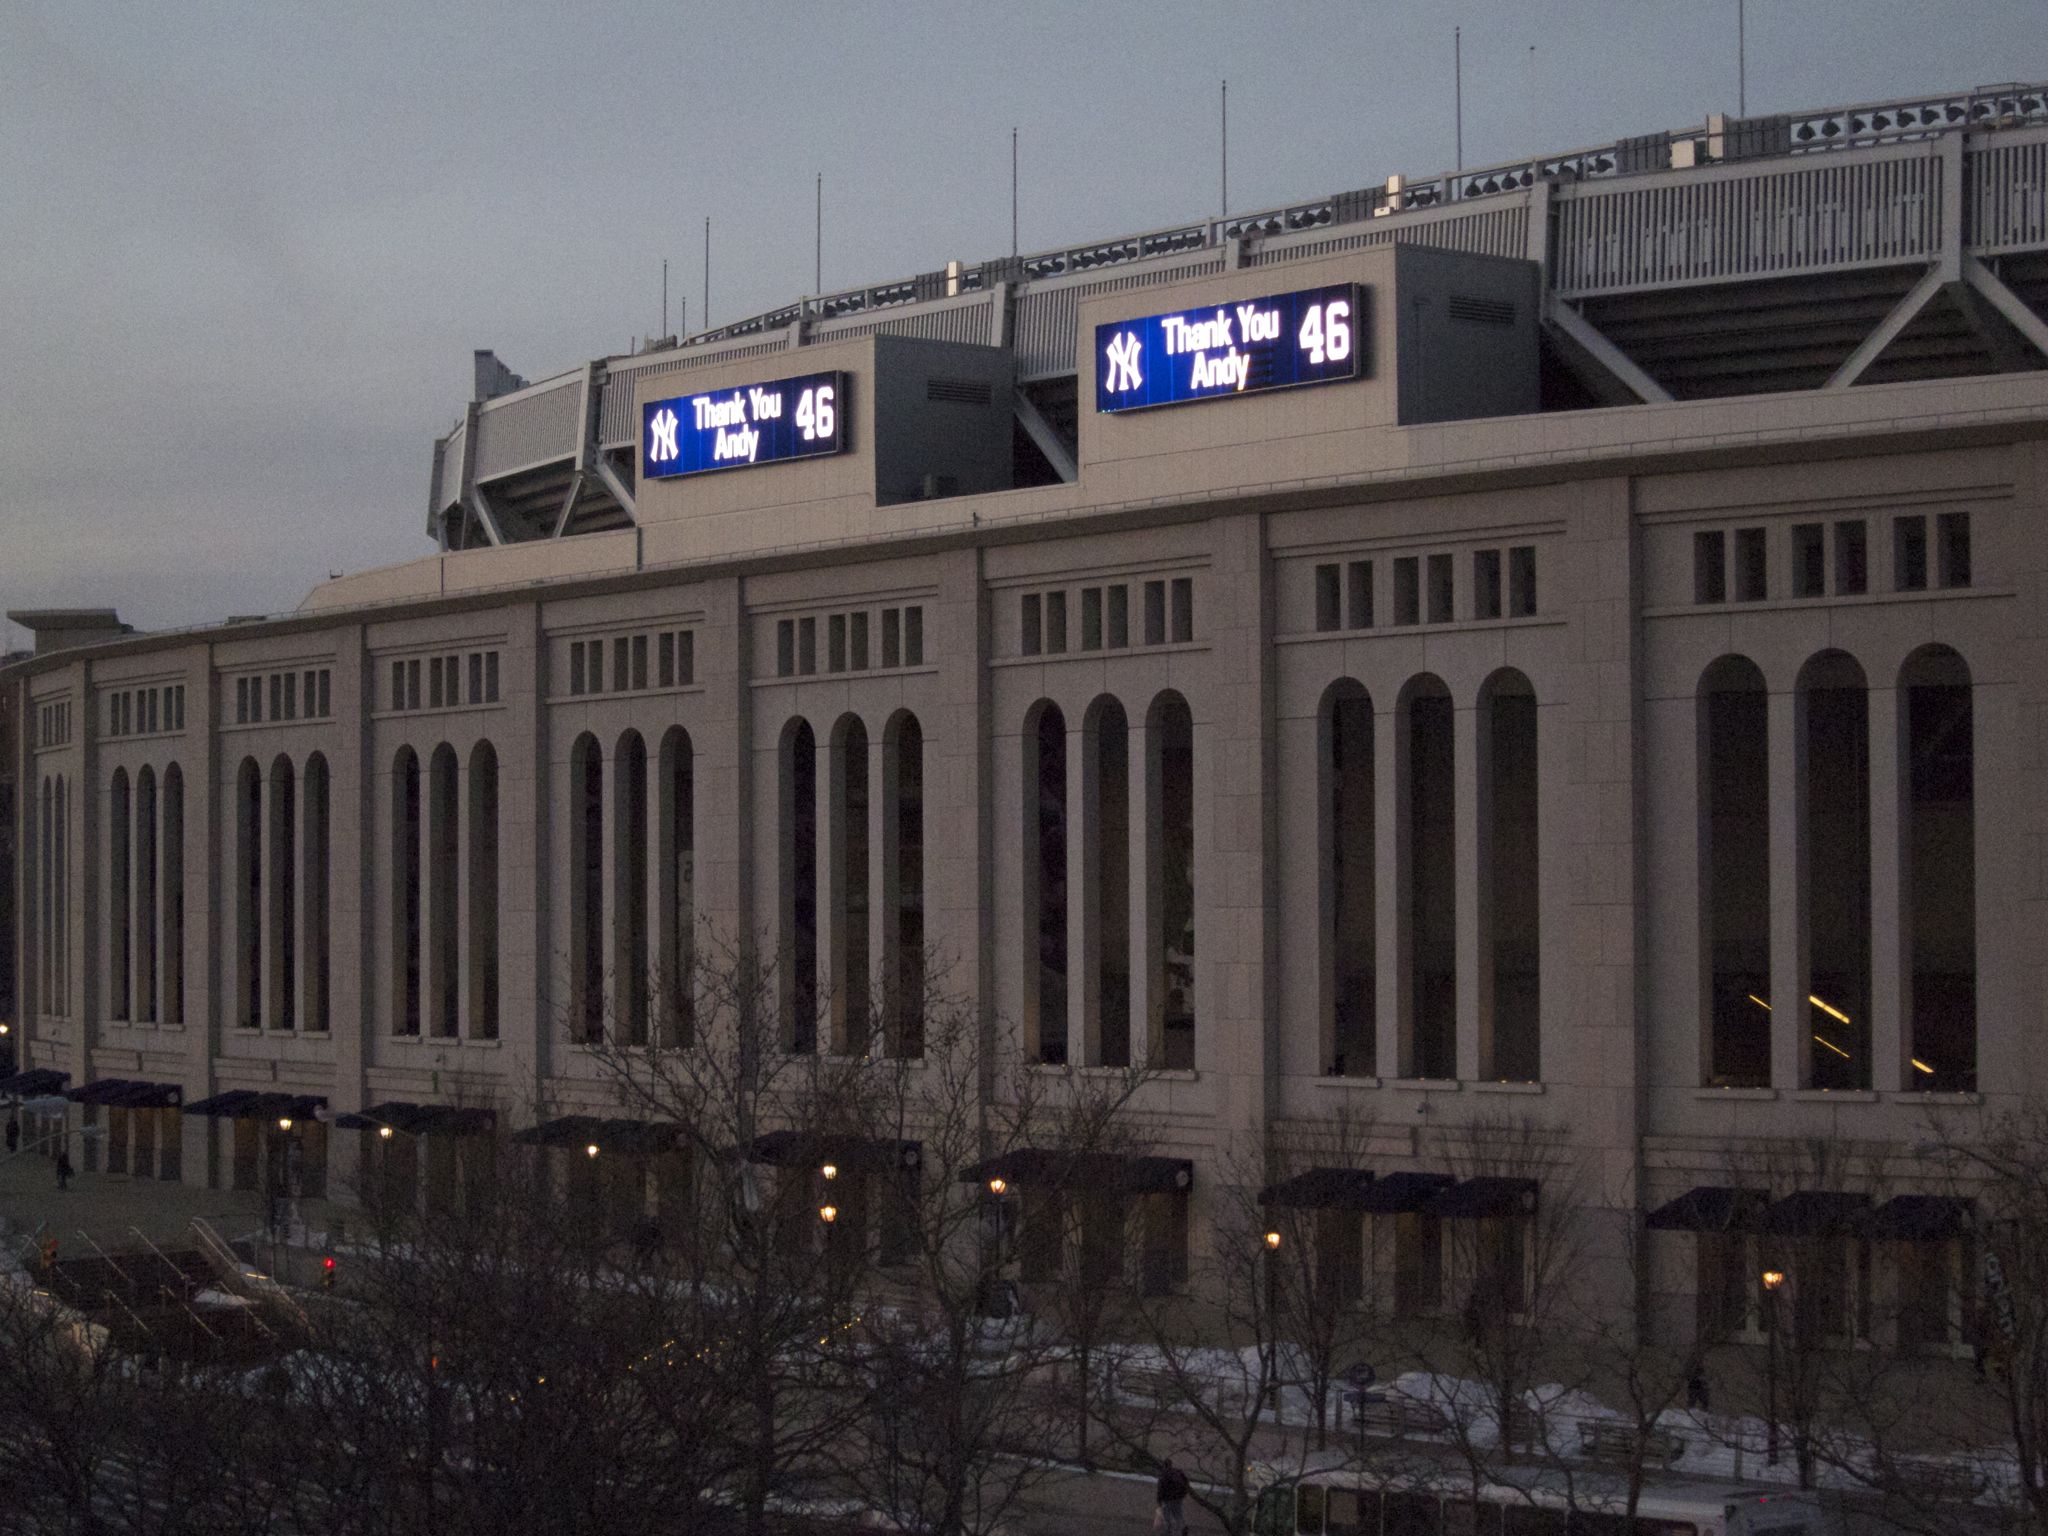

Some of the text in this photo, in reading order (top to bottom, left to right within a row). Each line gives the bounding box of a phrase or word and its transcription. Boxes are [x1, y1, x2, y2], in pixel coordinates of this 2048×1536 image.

[1161, 304, 1280, 356] Thank You
[1298, 300, 1351, 365] 46
[1190, 346, 1250, 392] Andy
[692, 387, 782, 430] Thank You
[795, 385, 835, 441] 46
[714, 423, 760, 463] Andy
